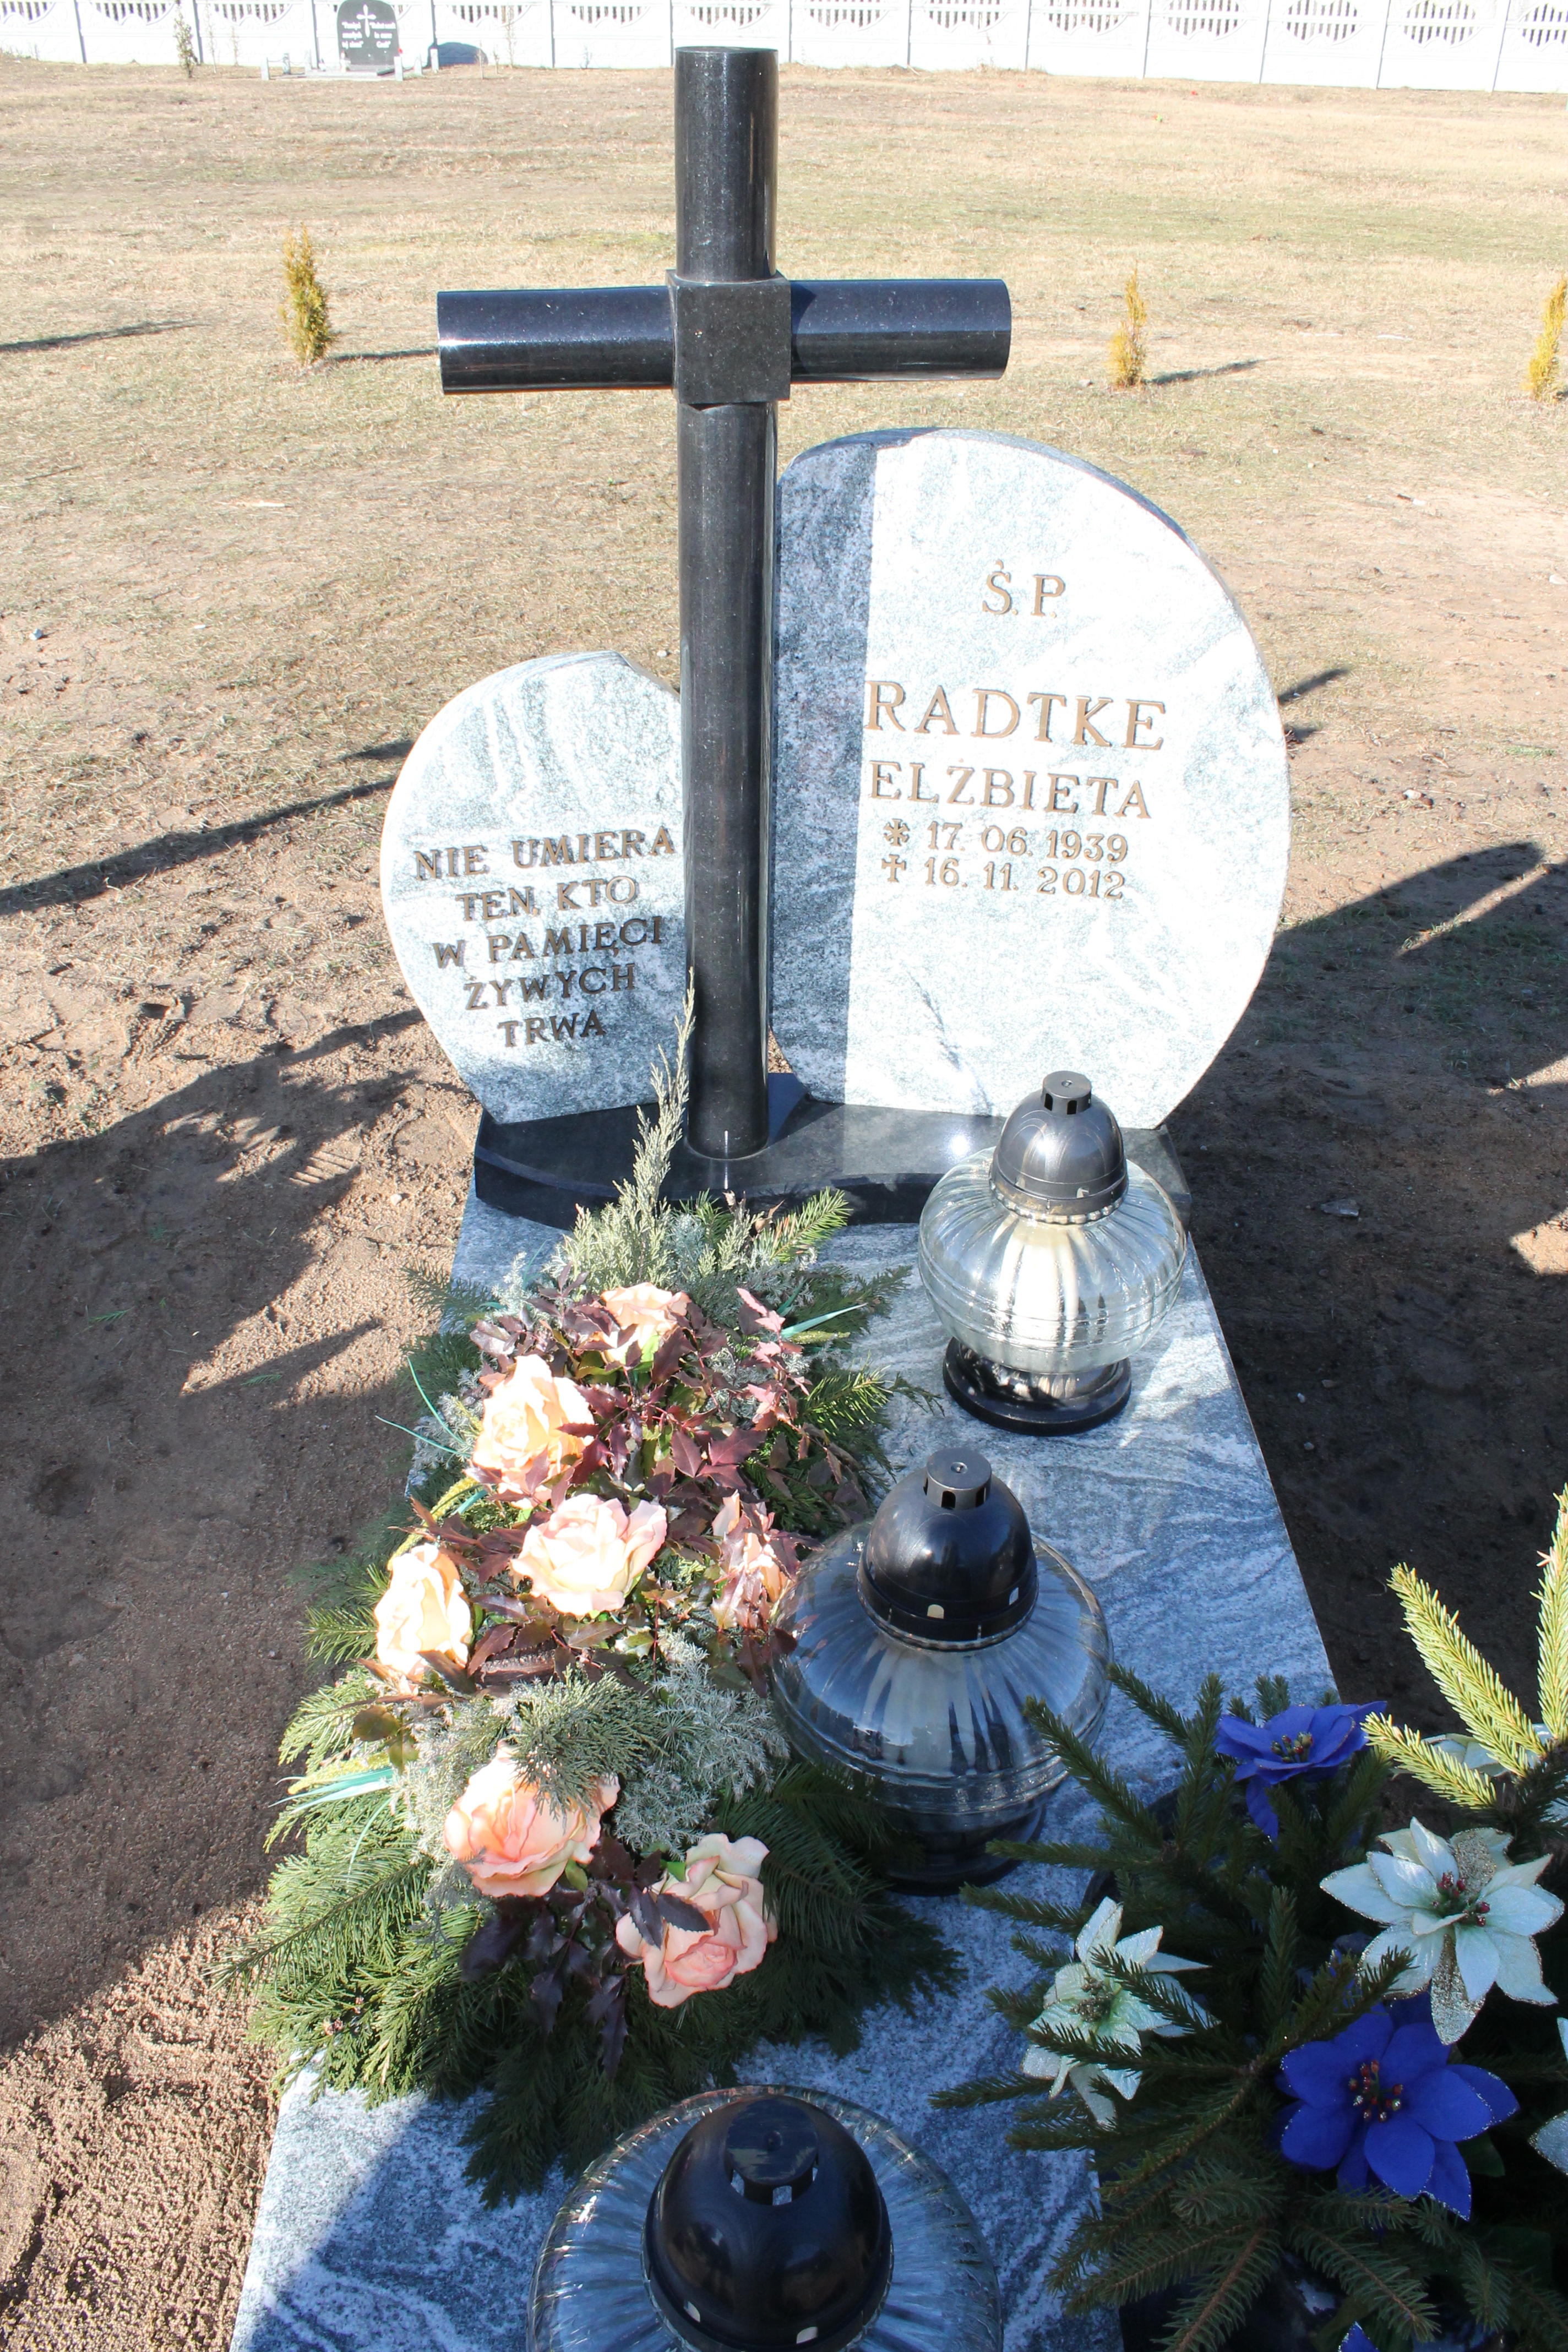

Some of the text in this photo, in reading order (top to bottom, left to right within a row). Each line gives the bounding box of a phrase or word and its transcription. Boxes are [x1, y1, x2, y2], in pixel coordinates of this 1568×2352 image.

[863, 680, 1166, 750] RADTKE
[868, 758, 1152, 819] ELŻBIETA
[414, 826, 675, 880] NIE UMIERA
[1047, 830, 1128, 863] 1939
[456, 875, 638, 921] TEN, KTO
[1037, 867, 1124, 900] 2012
[433, 916, 662, 968] W PAMIĘCI
[464, 963, 635, 1010] ŻYWYCH
[498, 1010, 606, 1047] TRWA
